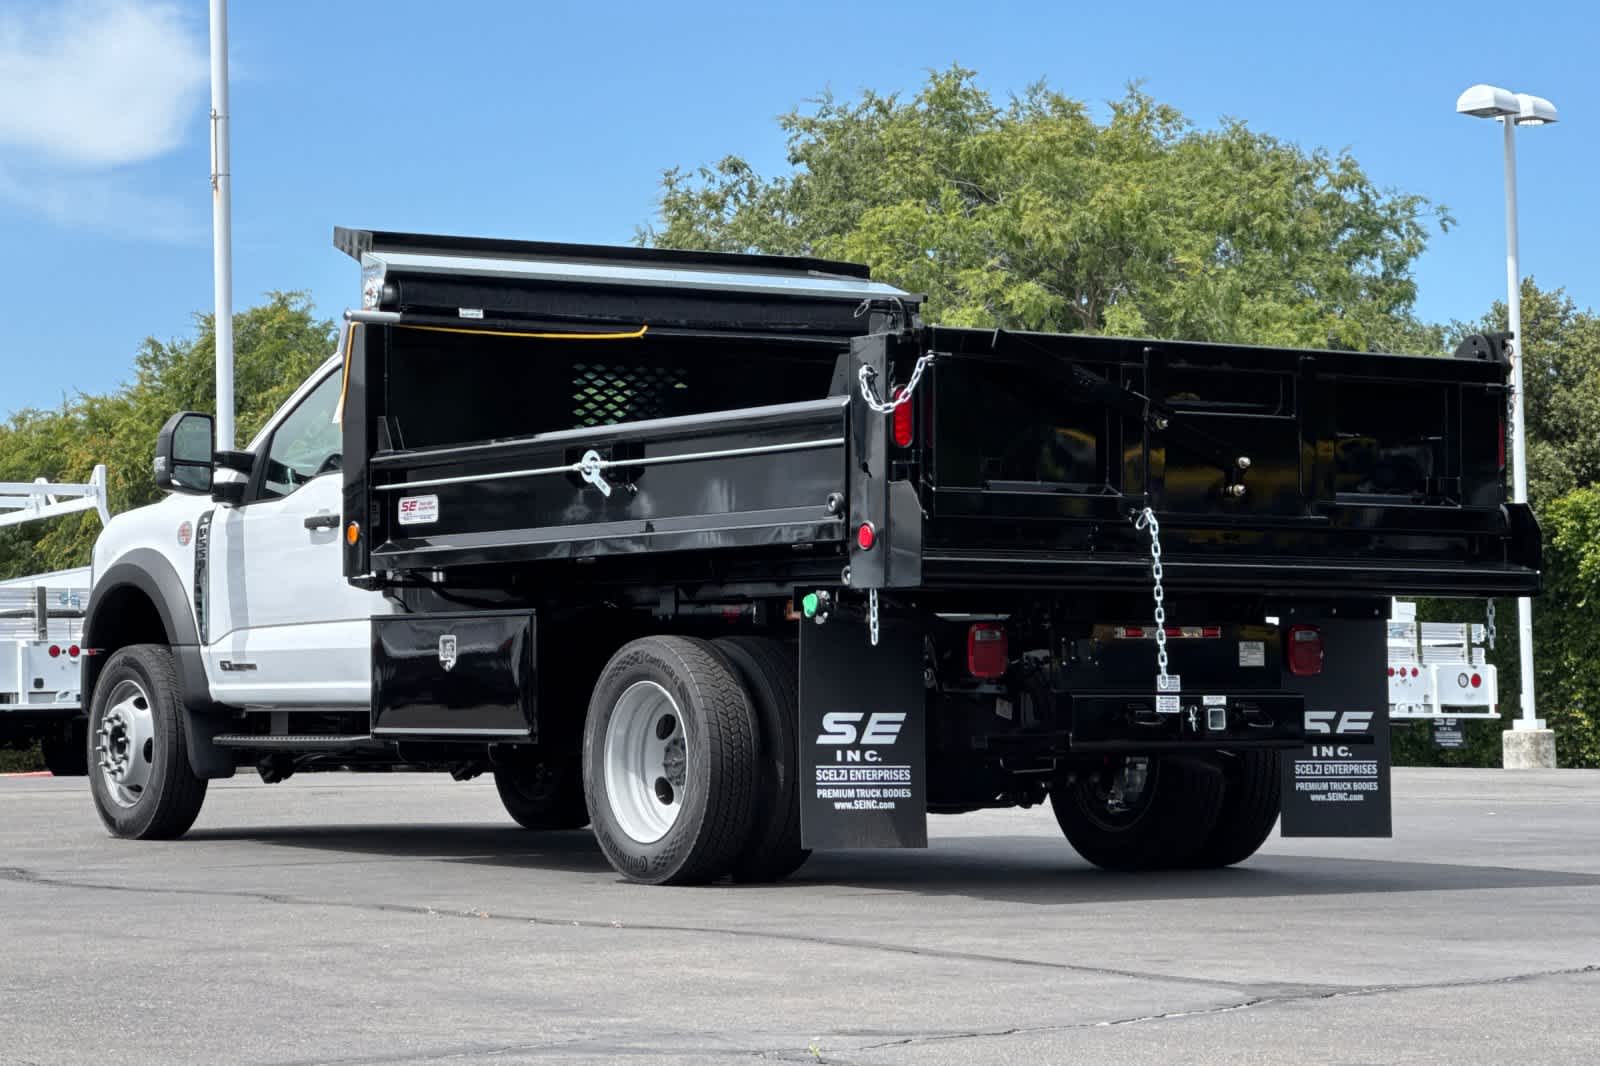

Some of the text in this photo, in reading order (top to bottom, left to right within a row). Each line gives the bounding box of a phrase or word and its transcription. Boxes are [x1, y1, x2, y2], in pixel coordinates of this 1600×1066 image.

[401, 501, 417, 512] SE
[816, 712, 907, 744] SE
[836, 749, 882, 762] INC.
[1312, 745, 1353, 757] INC.
[816, 769, 911, 781] SCELZI ENTERPRISES
[1295, 763, 1378, 775] SCELZI ENTERPRISES
[1296, 781, 1378, 791] PREMIUM TRUCK BODIES
[817, 788, 912, 799] PREMIUM TRUCK BODIES
[834, 799, 896, 810] www.SEINC.com
